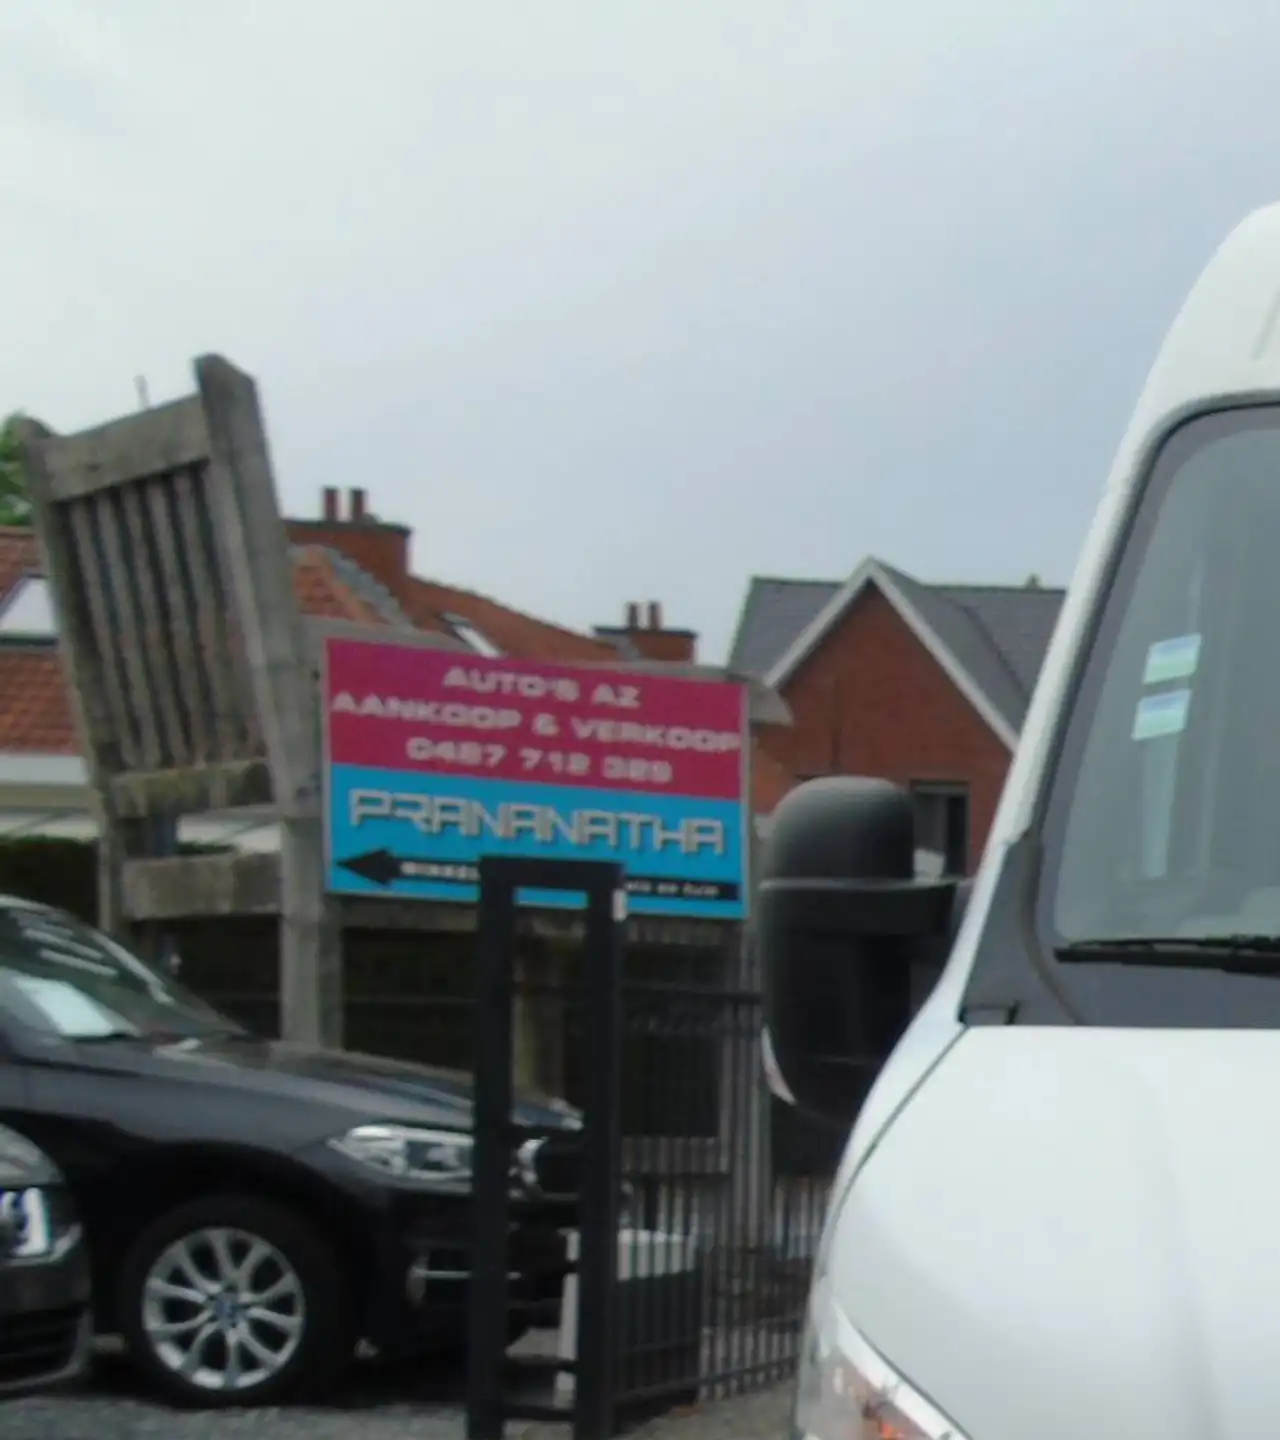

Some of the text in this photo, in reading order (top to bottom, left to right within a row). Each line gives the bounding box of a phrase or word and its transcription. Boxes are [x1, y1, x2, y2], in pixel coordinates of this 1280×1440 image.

[443, 666, 642, 709] AUTO'S AZ
[331, 690, 741, 753] AANKOOP & VERKOOP
[349, 787, 725, 856] PRANANATHA
